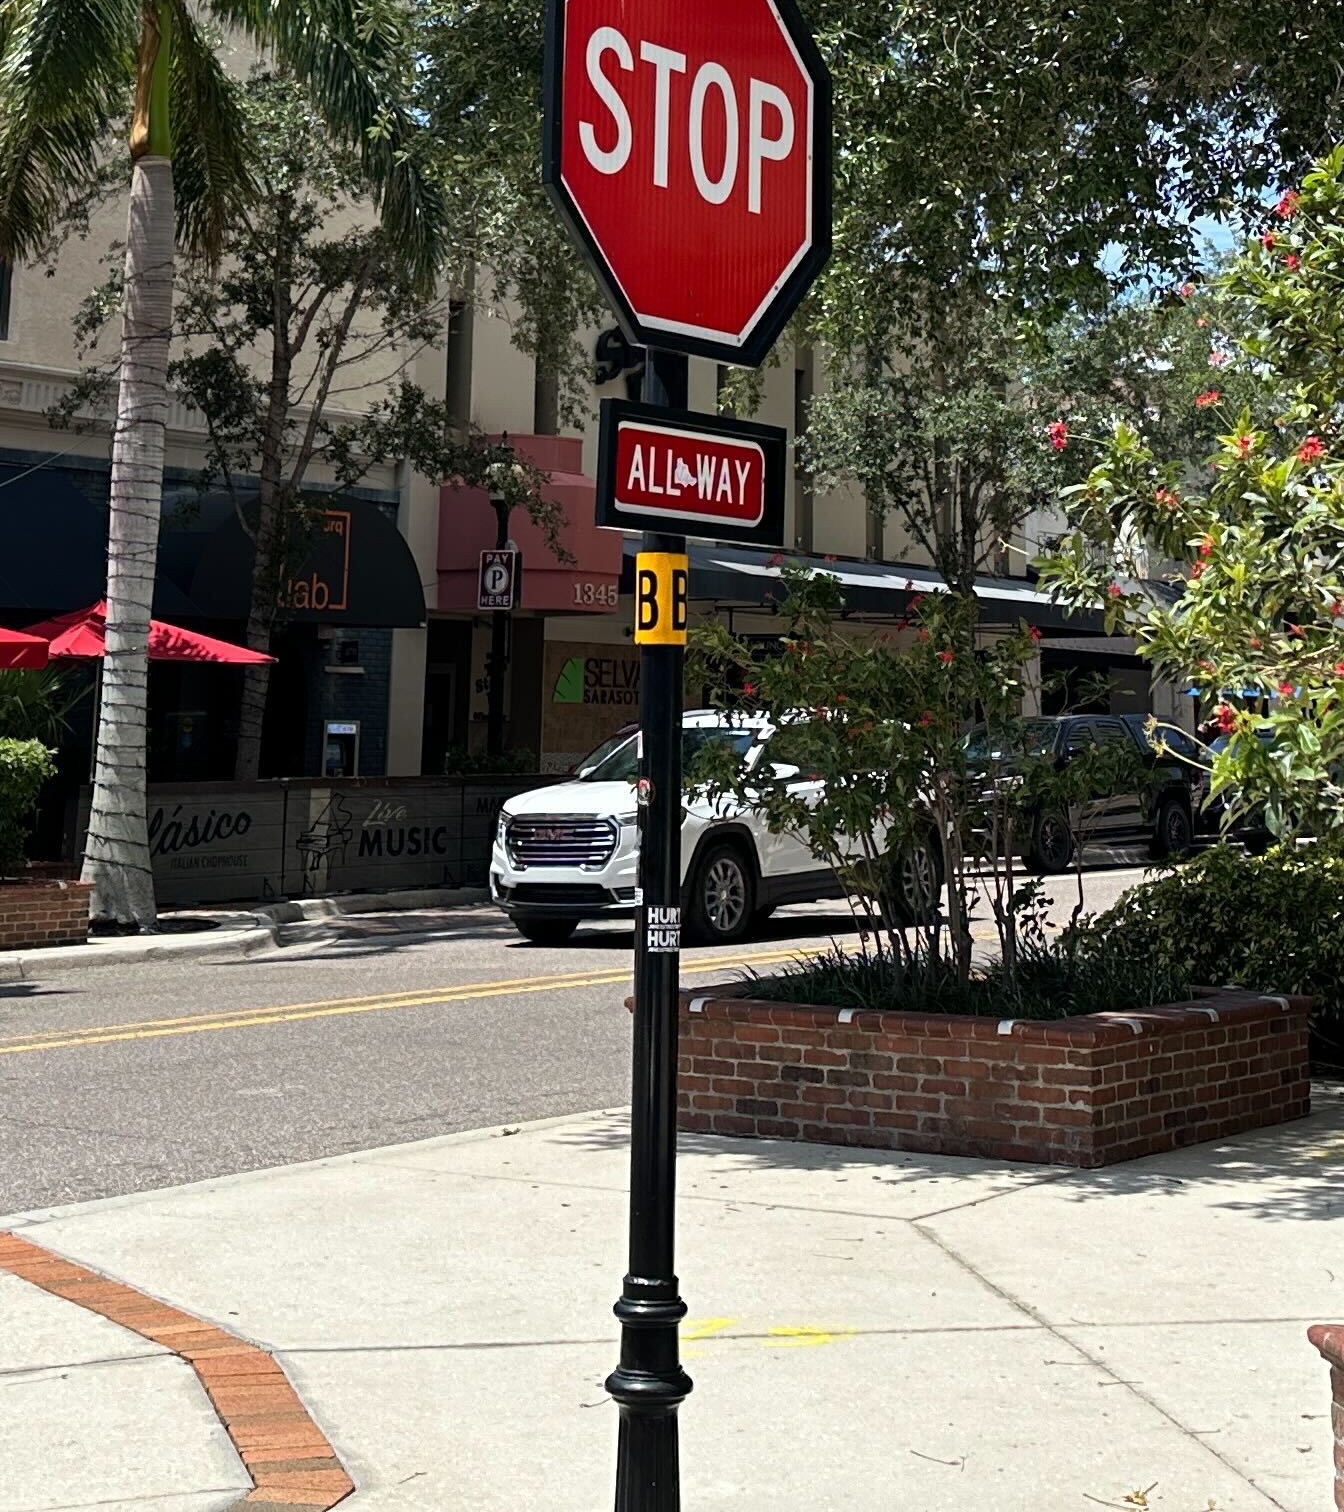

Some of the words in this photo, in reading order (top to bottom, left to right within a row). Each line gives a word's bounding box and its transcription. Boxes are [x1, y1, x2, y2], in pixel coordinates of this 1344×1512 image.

[578, 26, 795, 215] STOP
[627, 444, 682, 497] ALL
[696, 453, 752, 506] WAY
[486, 553, 509, 564] PAY
[480, 595, 510, 606] HERE
[573, 582, 619, 607] 1345
[638, 569, 659, 631] B
[584, 690, 641, 706] SARASOT
[362, 799, 406, 827] Live
[148, 804, 253, 859] lásico
[358, 826, 447, 857] MUSIC
